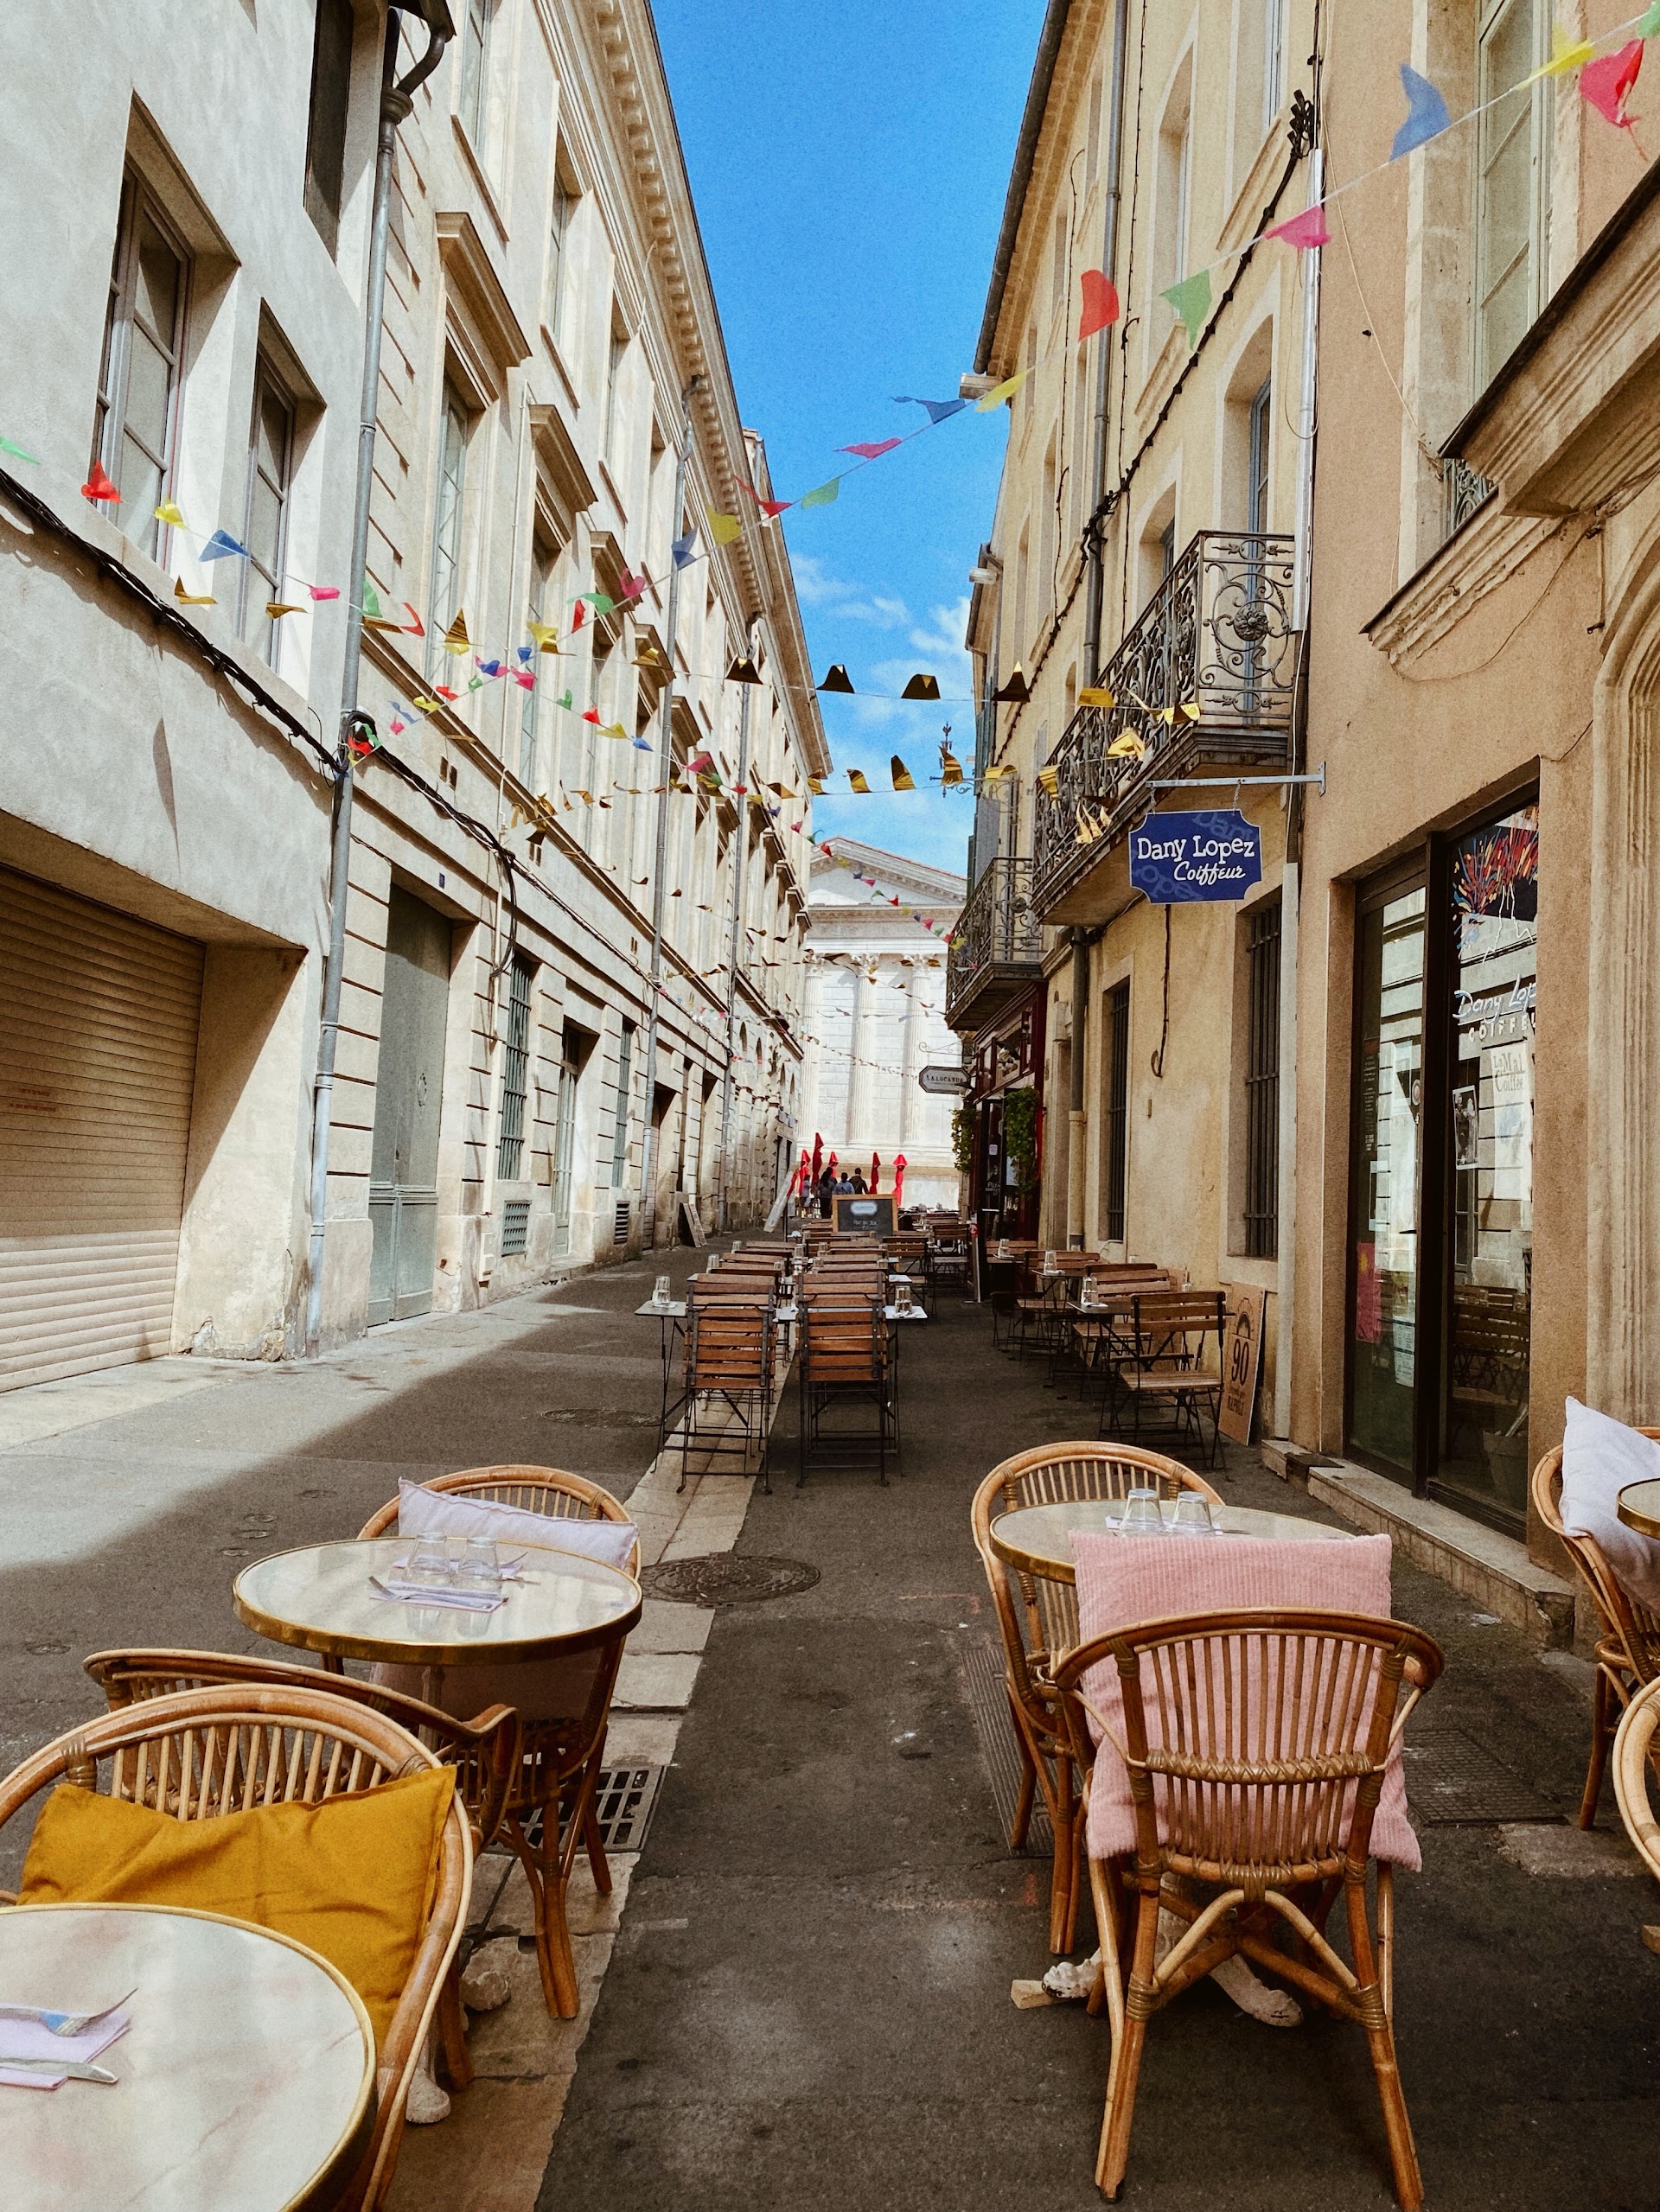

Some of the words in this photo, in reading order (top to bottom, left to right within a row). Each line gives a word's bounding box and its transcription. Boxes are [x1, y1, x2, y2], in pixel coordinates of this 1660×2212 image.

[1137, 837, 1187, 862] Dany
[1192, 835, 1255, 864] Lopez
[1174, 861, 1246, 886] Coiffeur
[1452, 989, 1503, 1025] Dany
[1231, 1338, 1249, 1386] 90
